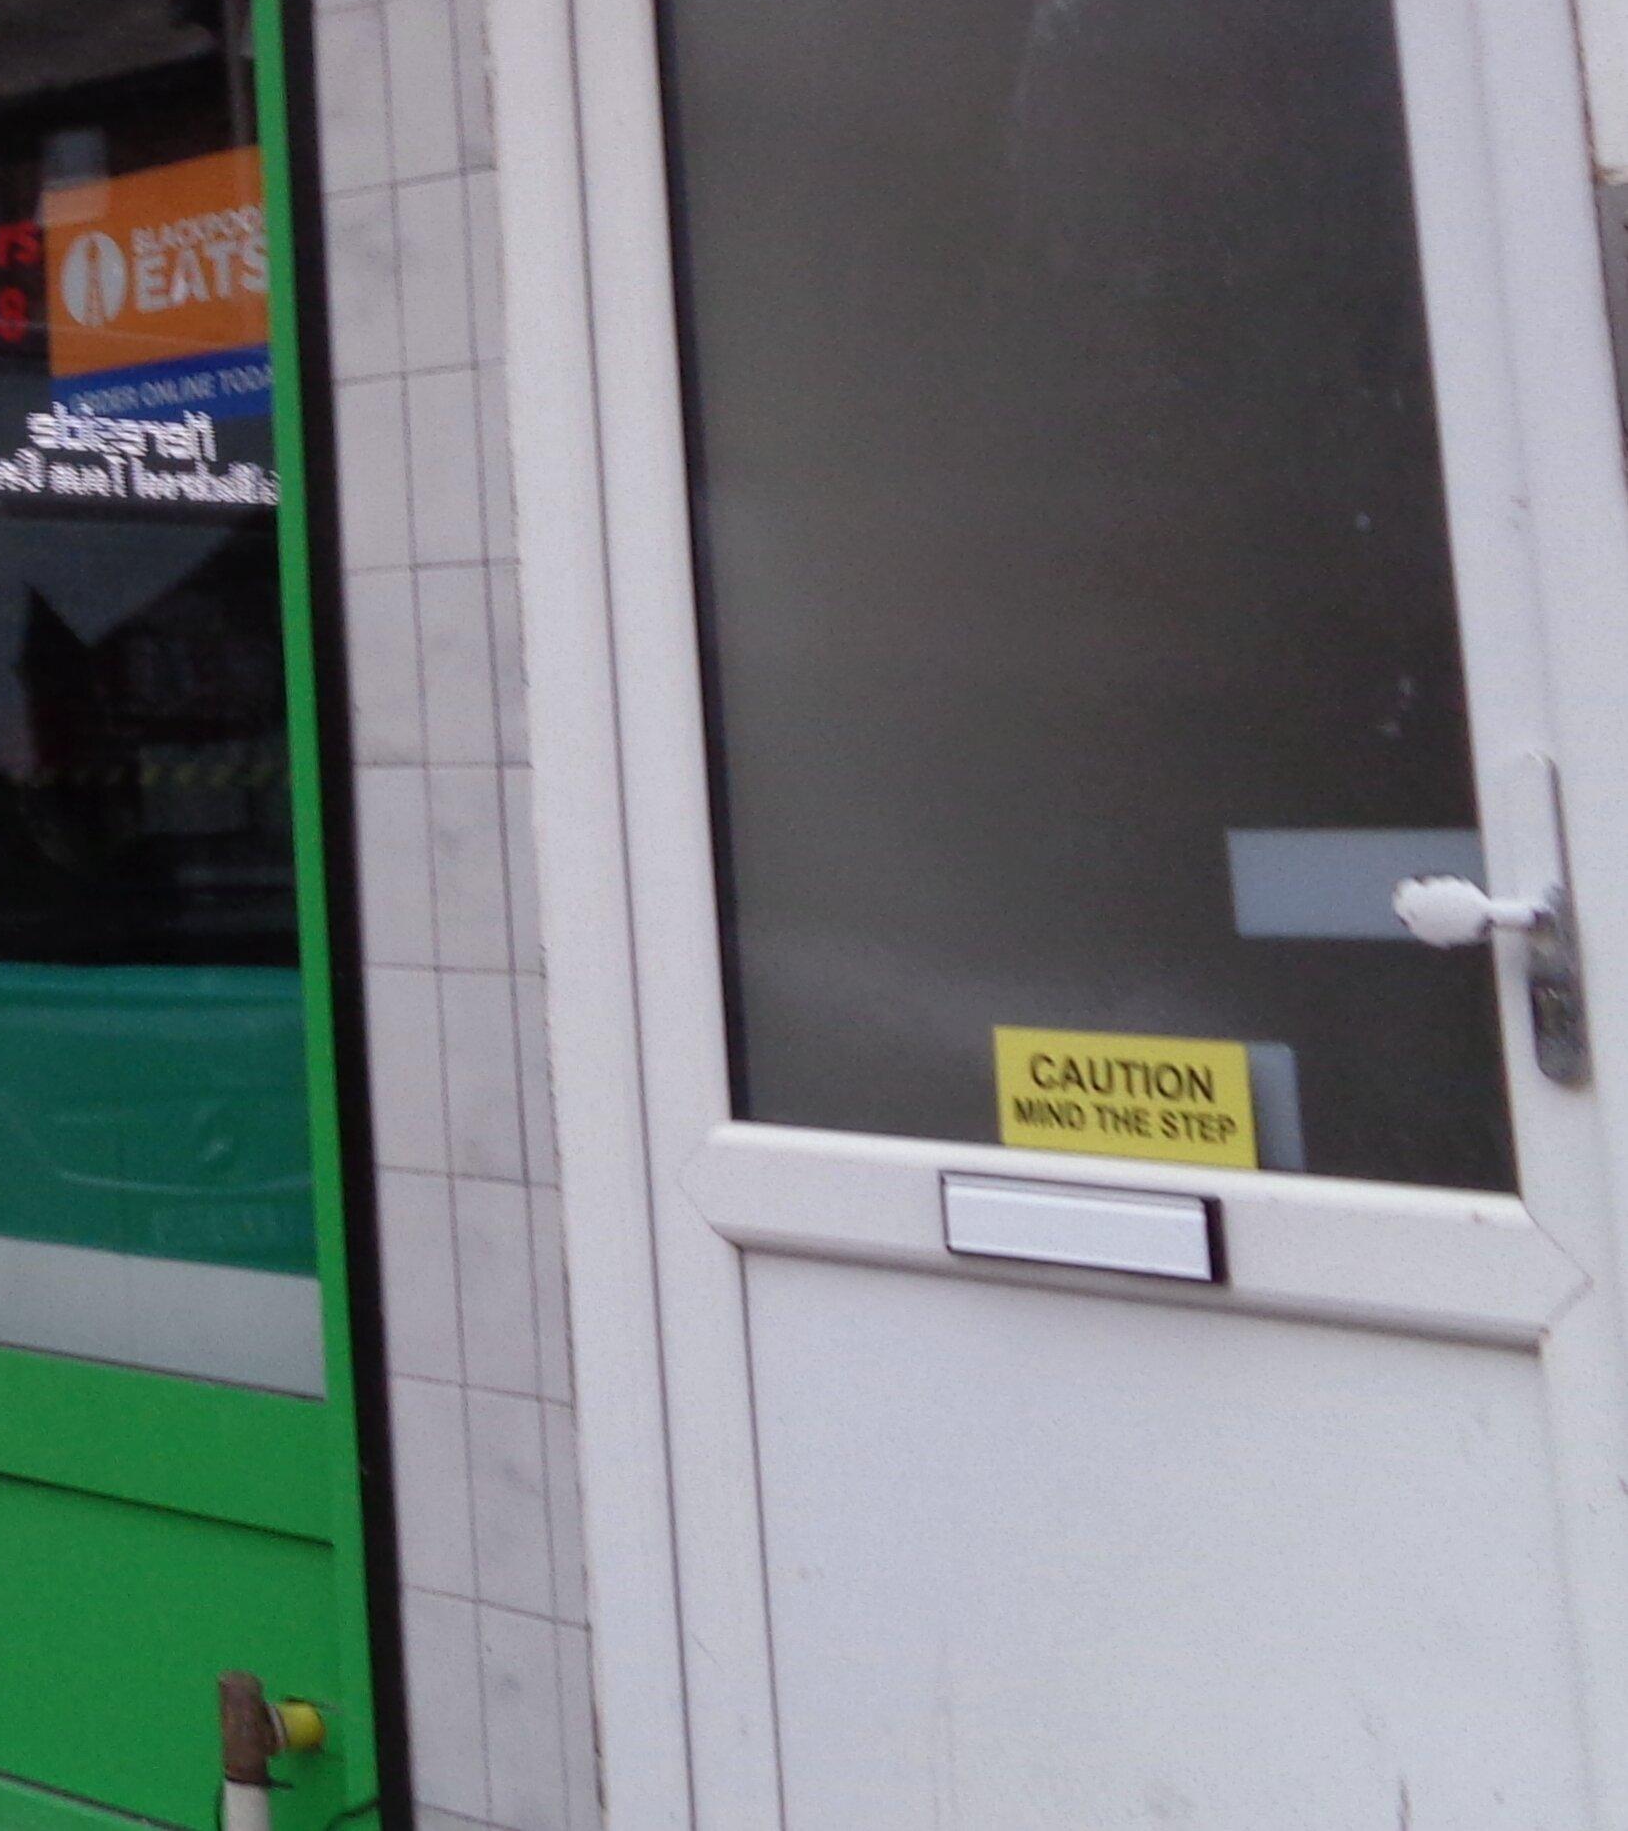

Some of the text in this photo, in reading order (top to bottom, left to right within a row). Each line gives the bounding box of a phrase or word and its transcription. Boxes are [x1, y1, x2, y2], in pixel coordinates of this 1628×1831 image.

[134, 237, 270, 313] EATS
[1029, 1052, 1216, 1104] CAUTION
[1011, 1096, 1239, 1144] MIND THE STEP
